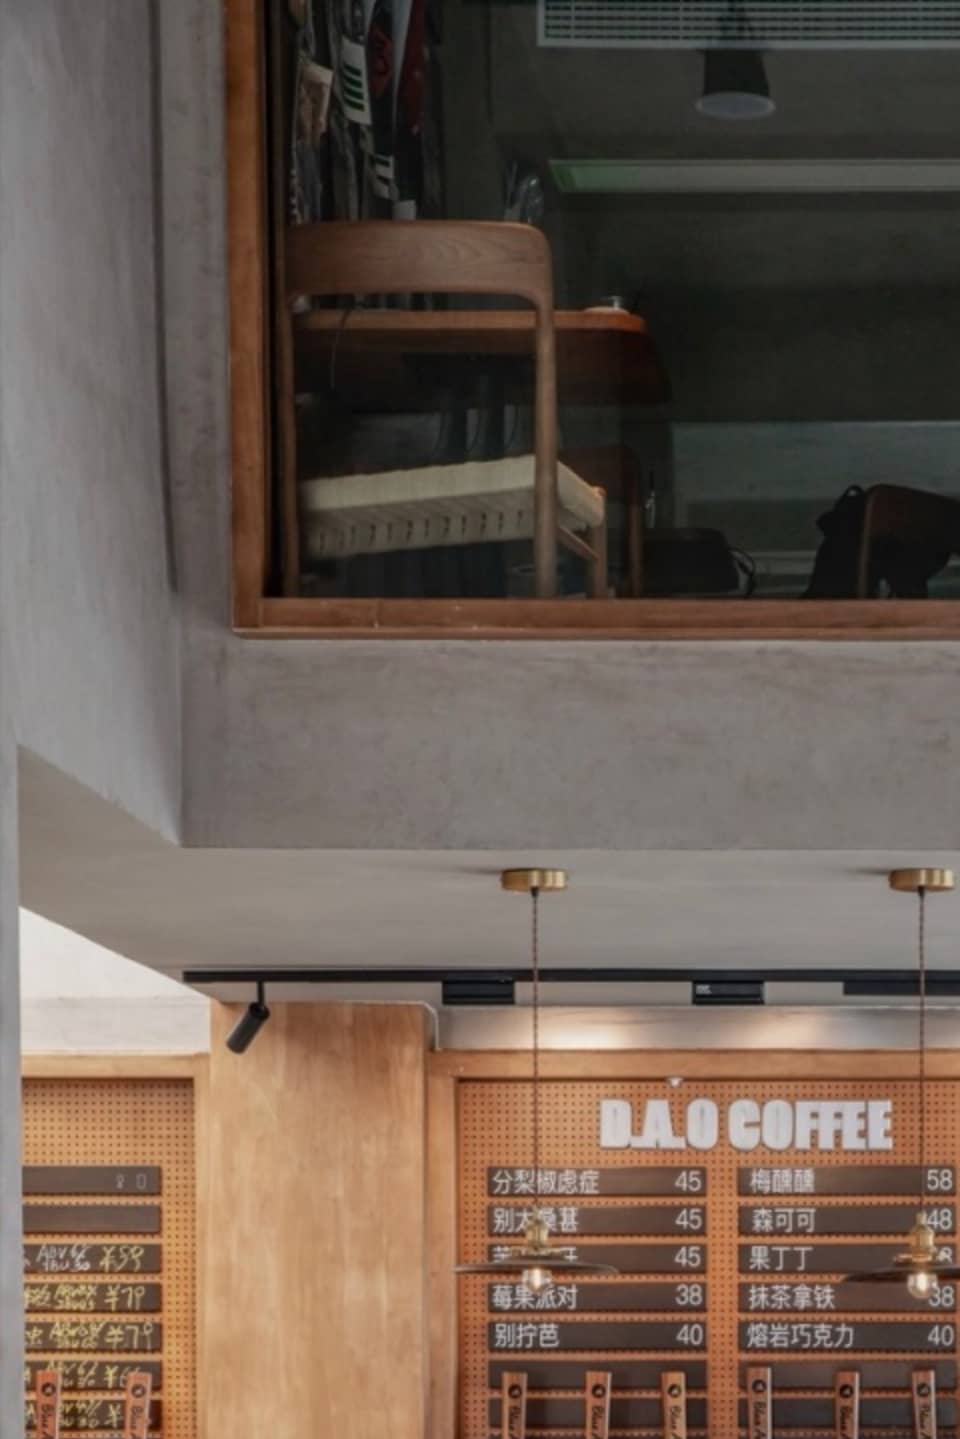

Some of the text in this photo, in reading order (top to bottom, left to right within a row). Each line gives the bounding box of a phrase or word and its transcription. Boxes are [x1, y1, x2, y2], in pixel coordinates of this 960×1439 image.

[728, 1099, 893, 1150] COFFEE
[674, 1170, 702, 1192] 45
[927, 1169, 953, 1191] 58
[675, 1208, 703, 1230] 45
[752, 1207, 953, 1233] 森可可 48
[674, 1246, 701, 1267] 45
[749, 1246, 814, 1271] 果丁丁
[675, 1284, 703, 1306] 38
[749, 1284, 955, 1310] 抹茶拿铁 38
[675, 1324, 704, 1345] 40
[747, 1323, 955, 1349] 熔岩巧克力 40
